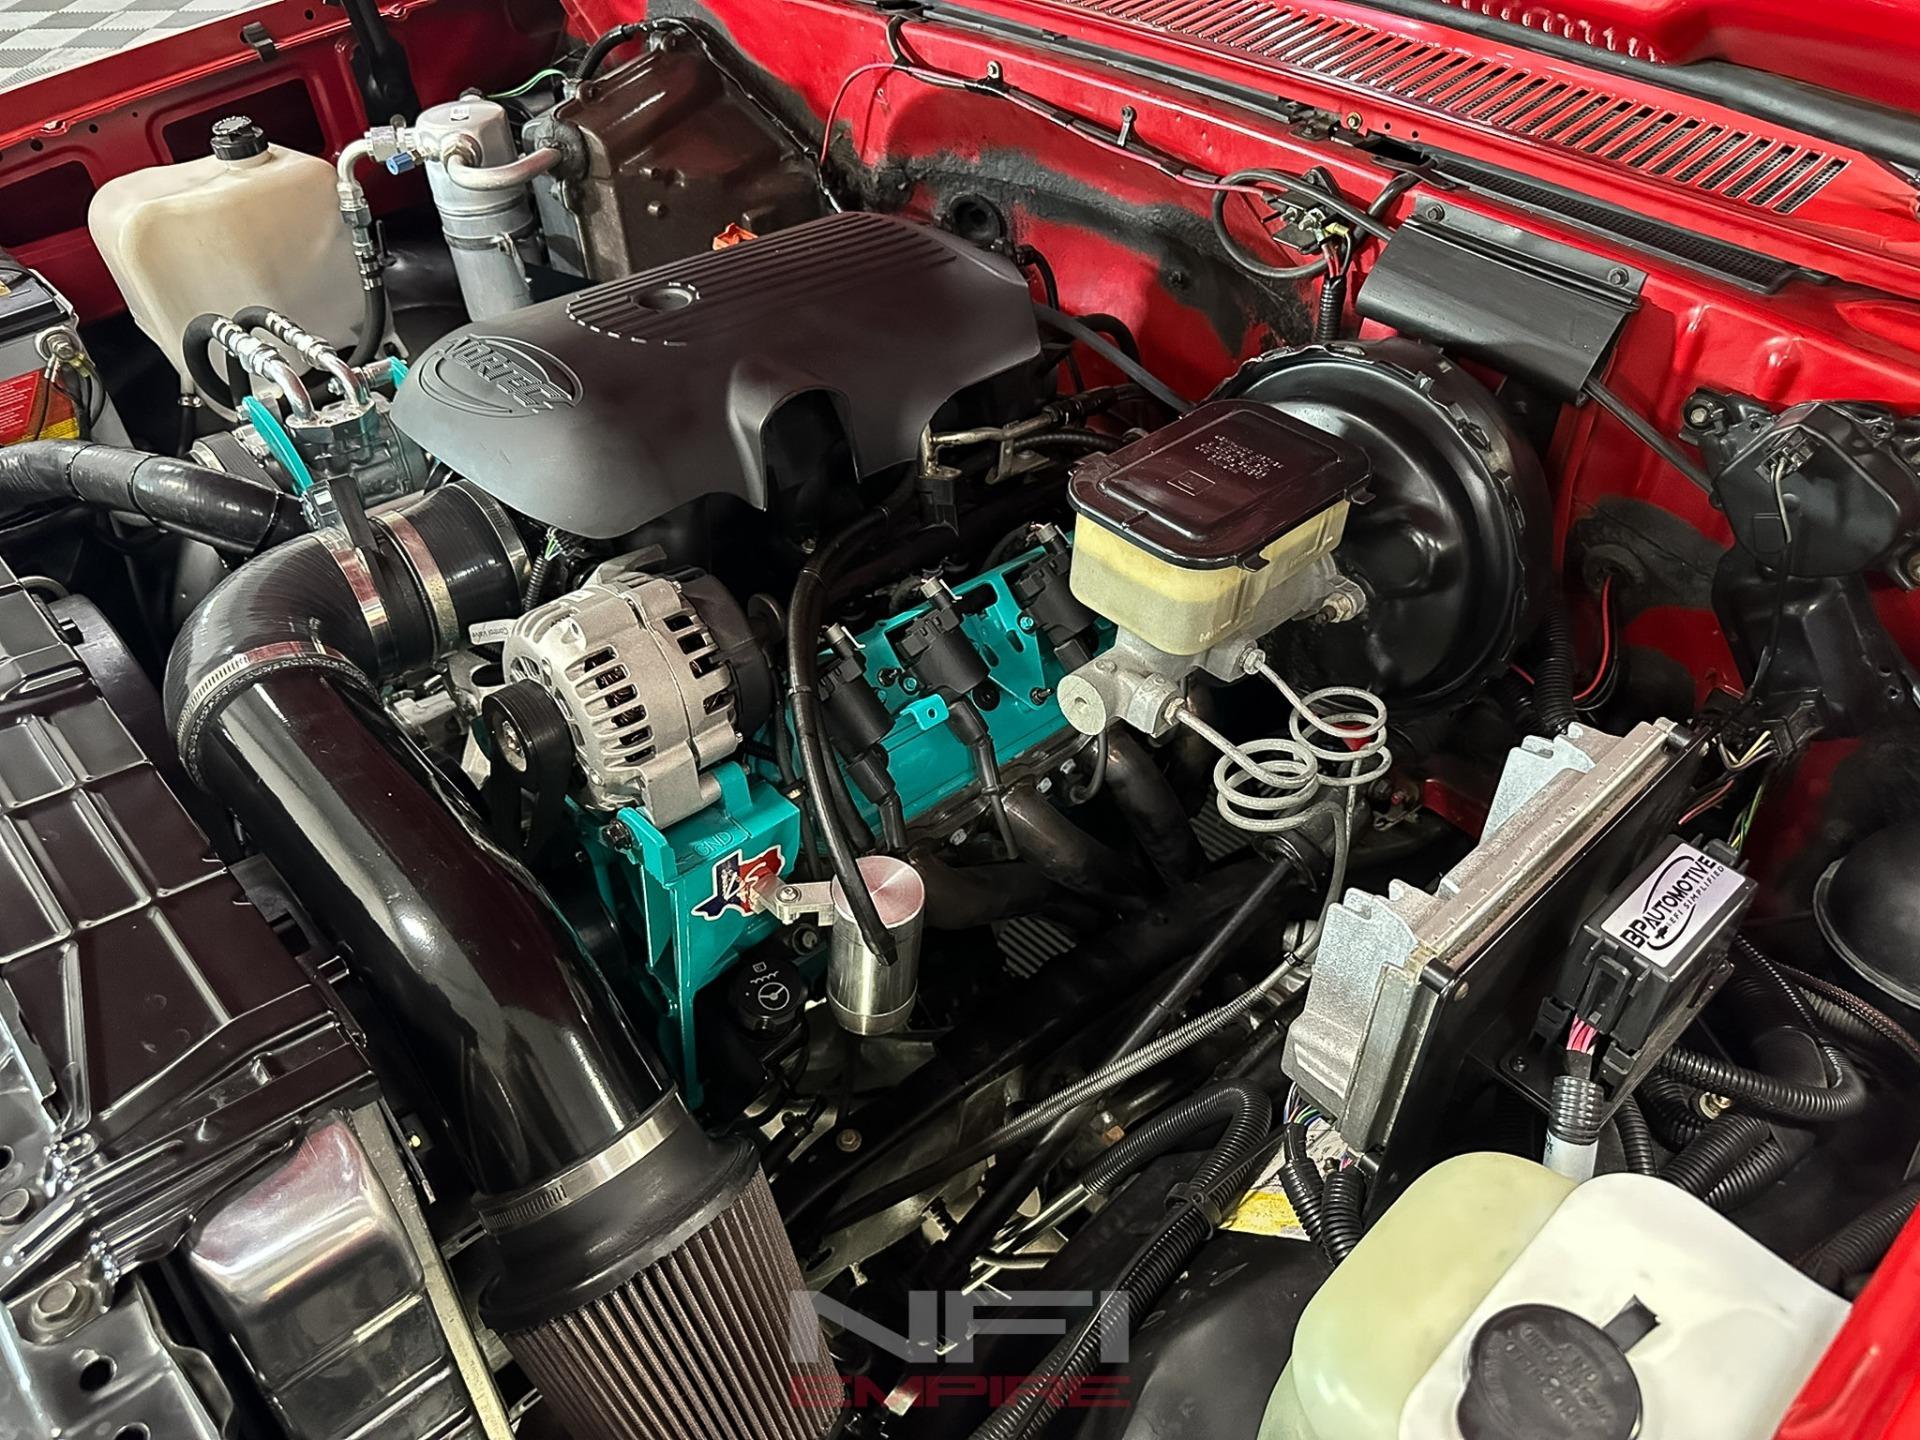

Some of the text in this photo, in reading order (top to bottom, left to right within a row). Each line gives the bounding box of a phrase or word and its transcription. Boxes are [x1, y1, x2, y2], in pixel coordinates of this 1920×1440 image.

[445, 334, 563, 408] VORTEC
[693, 831, 735, 857] GND
[1670, 865, 1725, 926] EFI SIMPLIFIED
